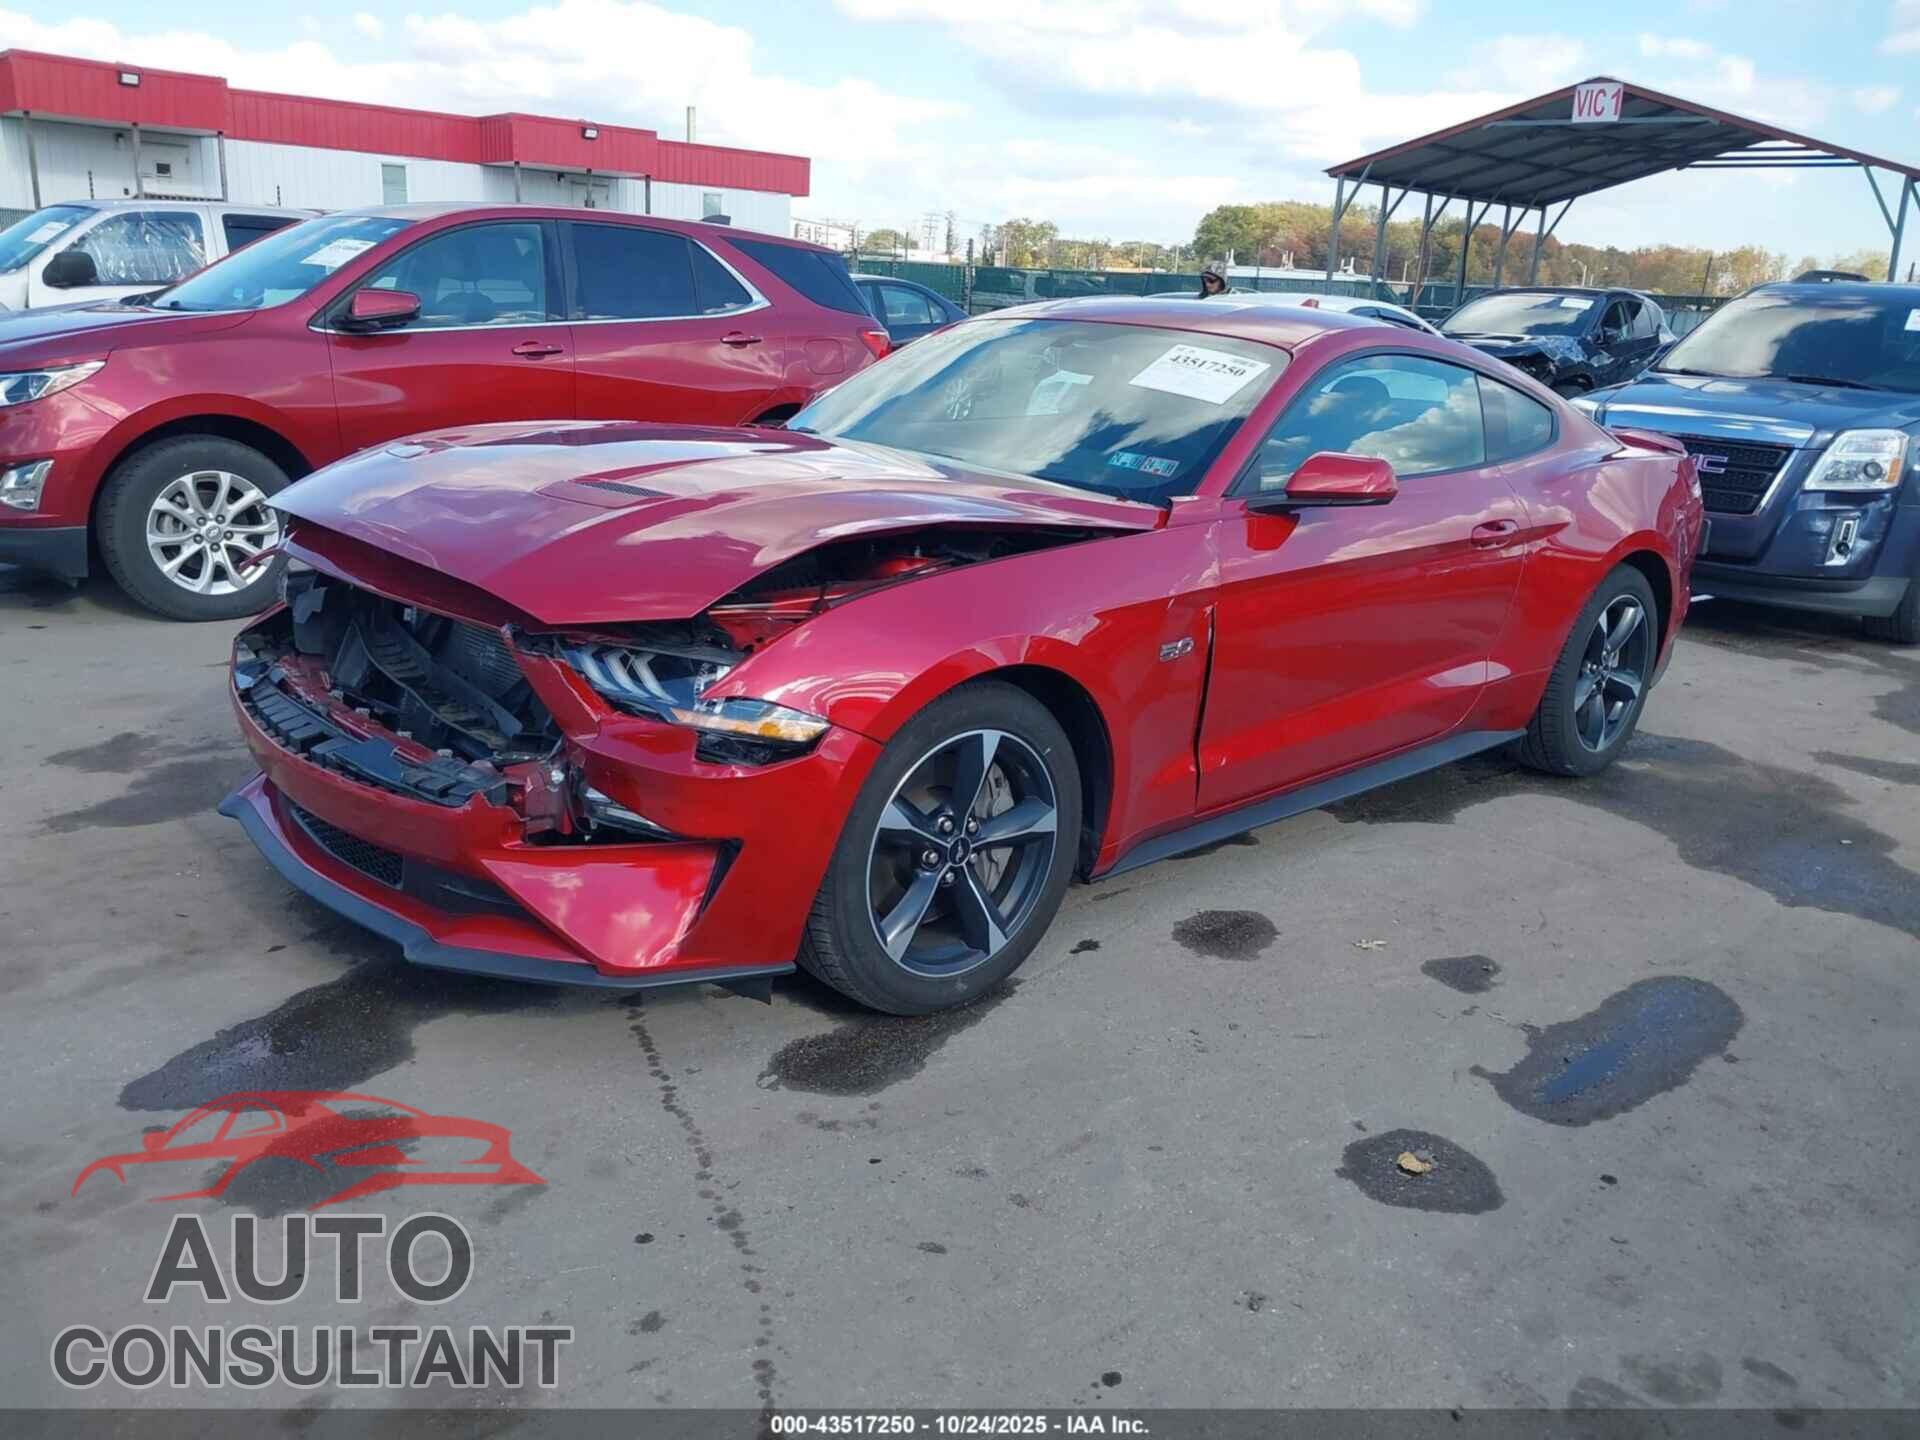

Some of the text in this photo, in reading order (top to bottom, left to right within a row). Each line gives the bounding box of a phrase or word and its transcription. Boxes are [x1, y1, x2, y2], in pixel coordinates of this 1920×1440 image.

[1577, 87, 1622, 117] VIC 1
[1169, 353, 1247, 377] 43517250
